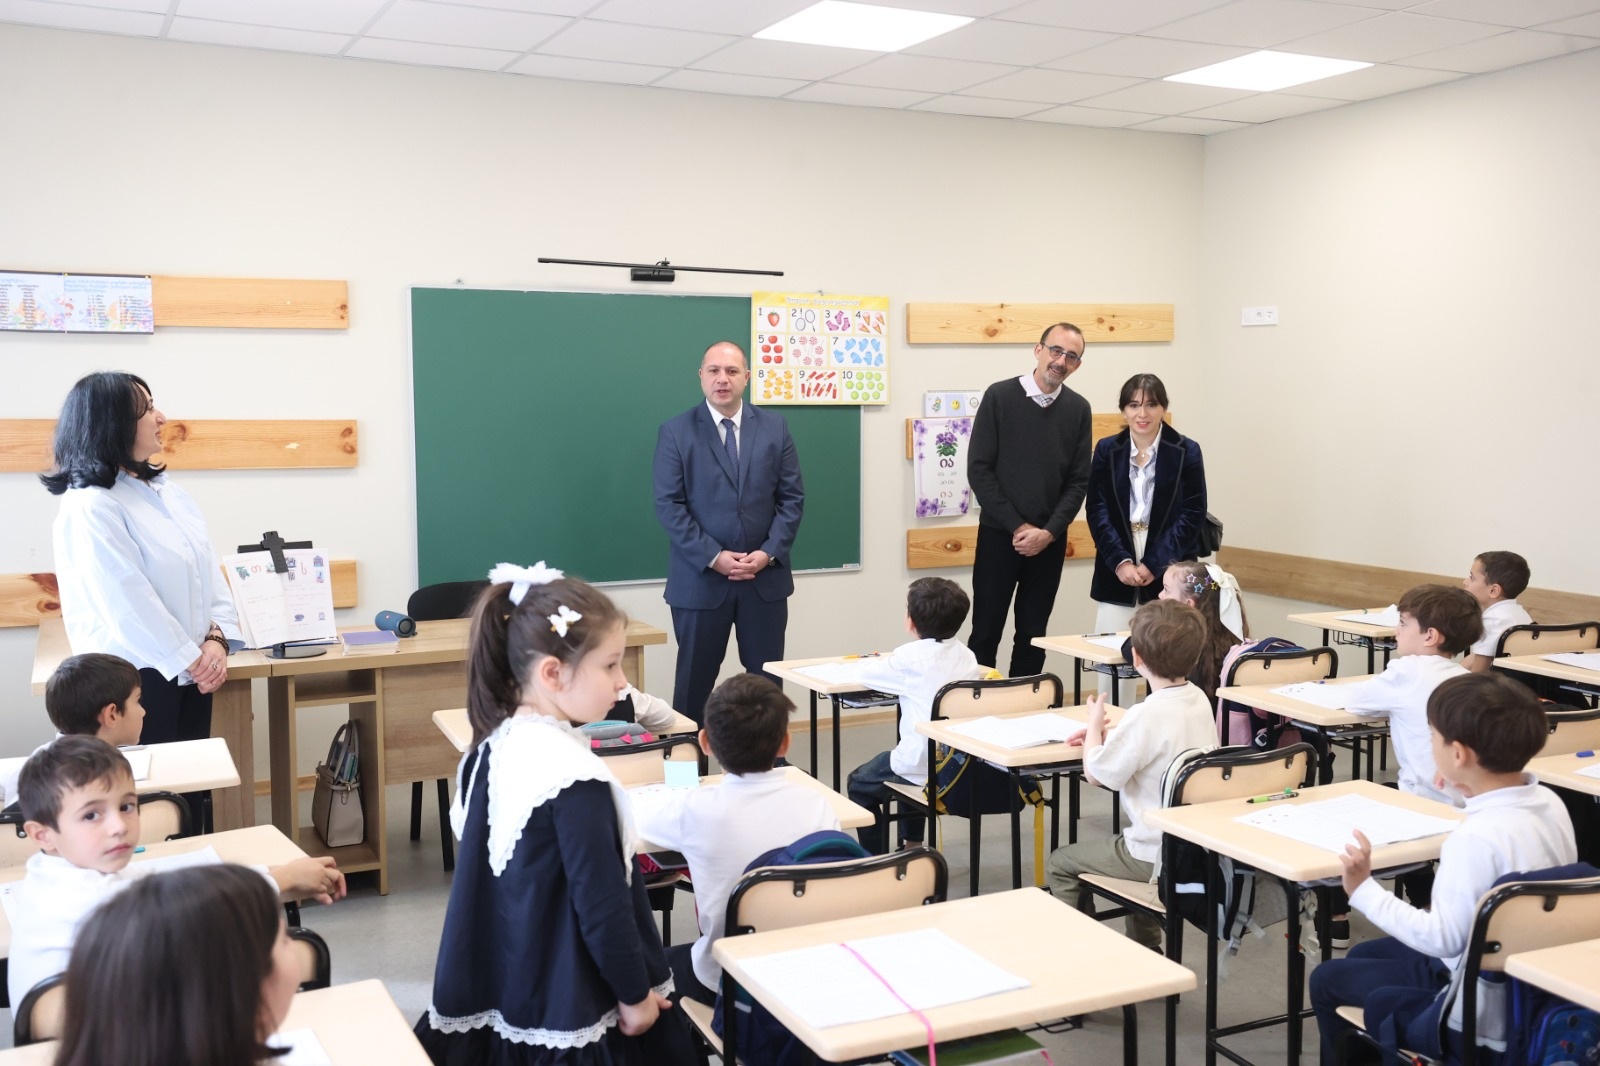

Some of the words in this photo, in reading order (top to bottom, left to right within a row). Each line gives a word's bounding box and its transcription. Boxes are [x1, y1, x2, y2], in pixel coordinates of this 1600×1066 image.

[758, 307, 763, 316] 1
[791, 308, 797, 317] 2
[825, 310, 831, 318] 3
[855, 310, 861, 319] 4
[758, 335, 764, 343] 5
[789, 336, 796, 344] 6
[833, 336, 839, 345] 7
[758, 370, 764, 378] 8
[799, 370, 805, 379] 9
[842, 371, 853, 379] 10
[940, 458, 954, 468] ია
